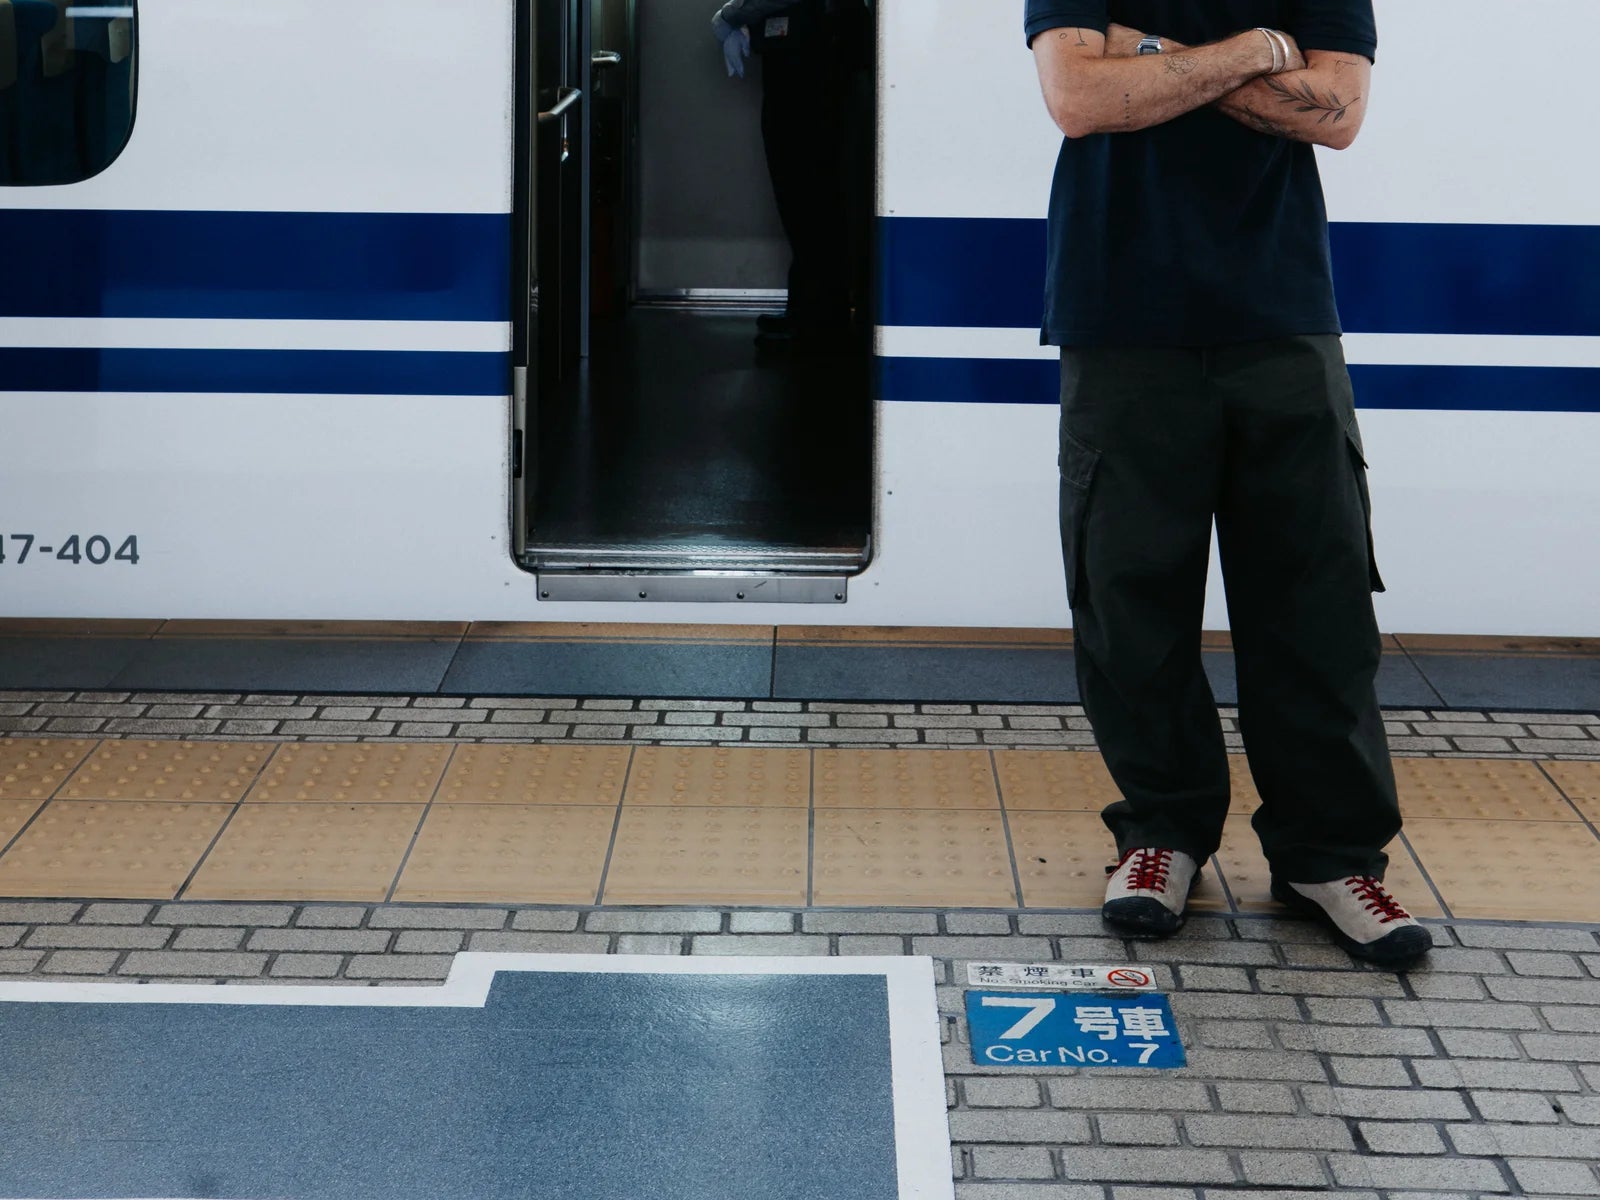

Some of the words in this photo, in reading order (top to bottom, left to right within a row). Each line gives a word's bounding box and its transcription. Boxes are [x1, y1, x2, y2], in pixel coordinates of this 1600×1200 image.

[0, 533, 140, 565] 7-404
[984, 1044, 1052, 1063] Car
[1057, 1046, 1118, 1064] No.
[1128, 1043, 1160, 1064] 7
